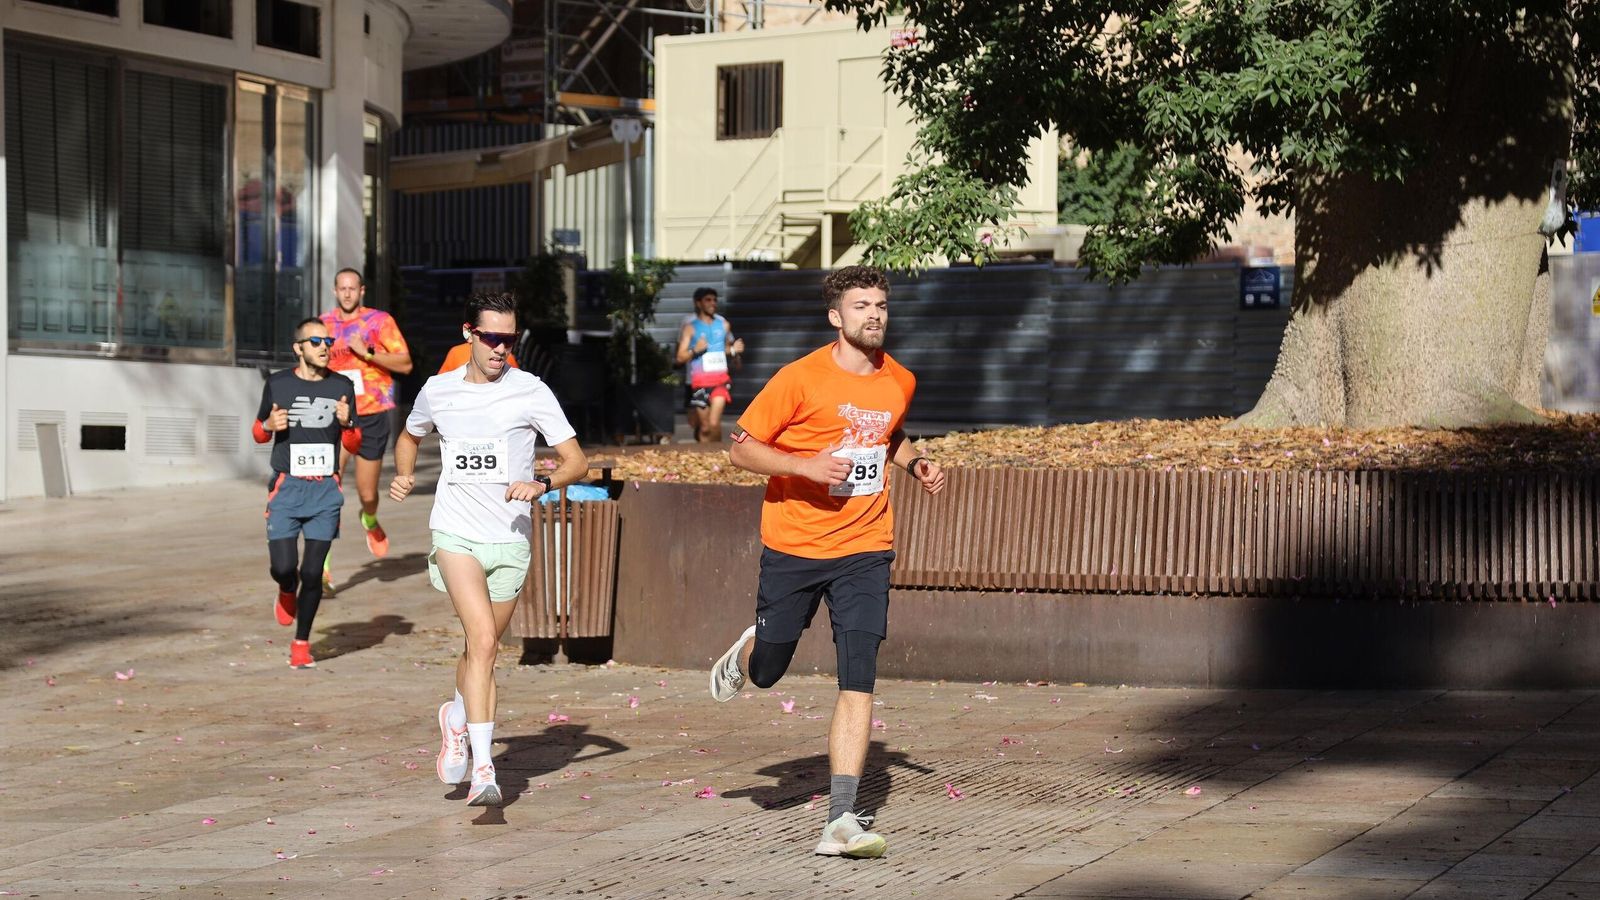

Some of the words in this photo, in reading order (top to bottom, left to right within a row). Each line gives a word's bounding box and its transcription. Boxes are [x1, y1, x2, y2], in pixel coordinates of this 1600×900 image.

[297, 455, 326, 466] 811
[455, 455, 497, 469] 339
[854, 463, 878, 481] 93
